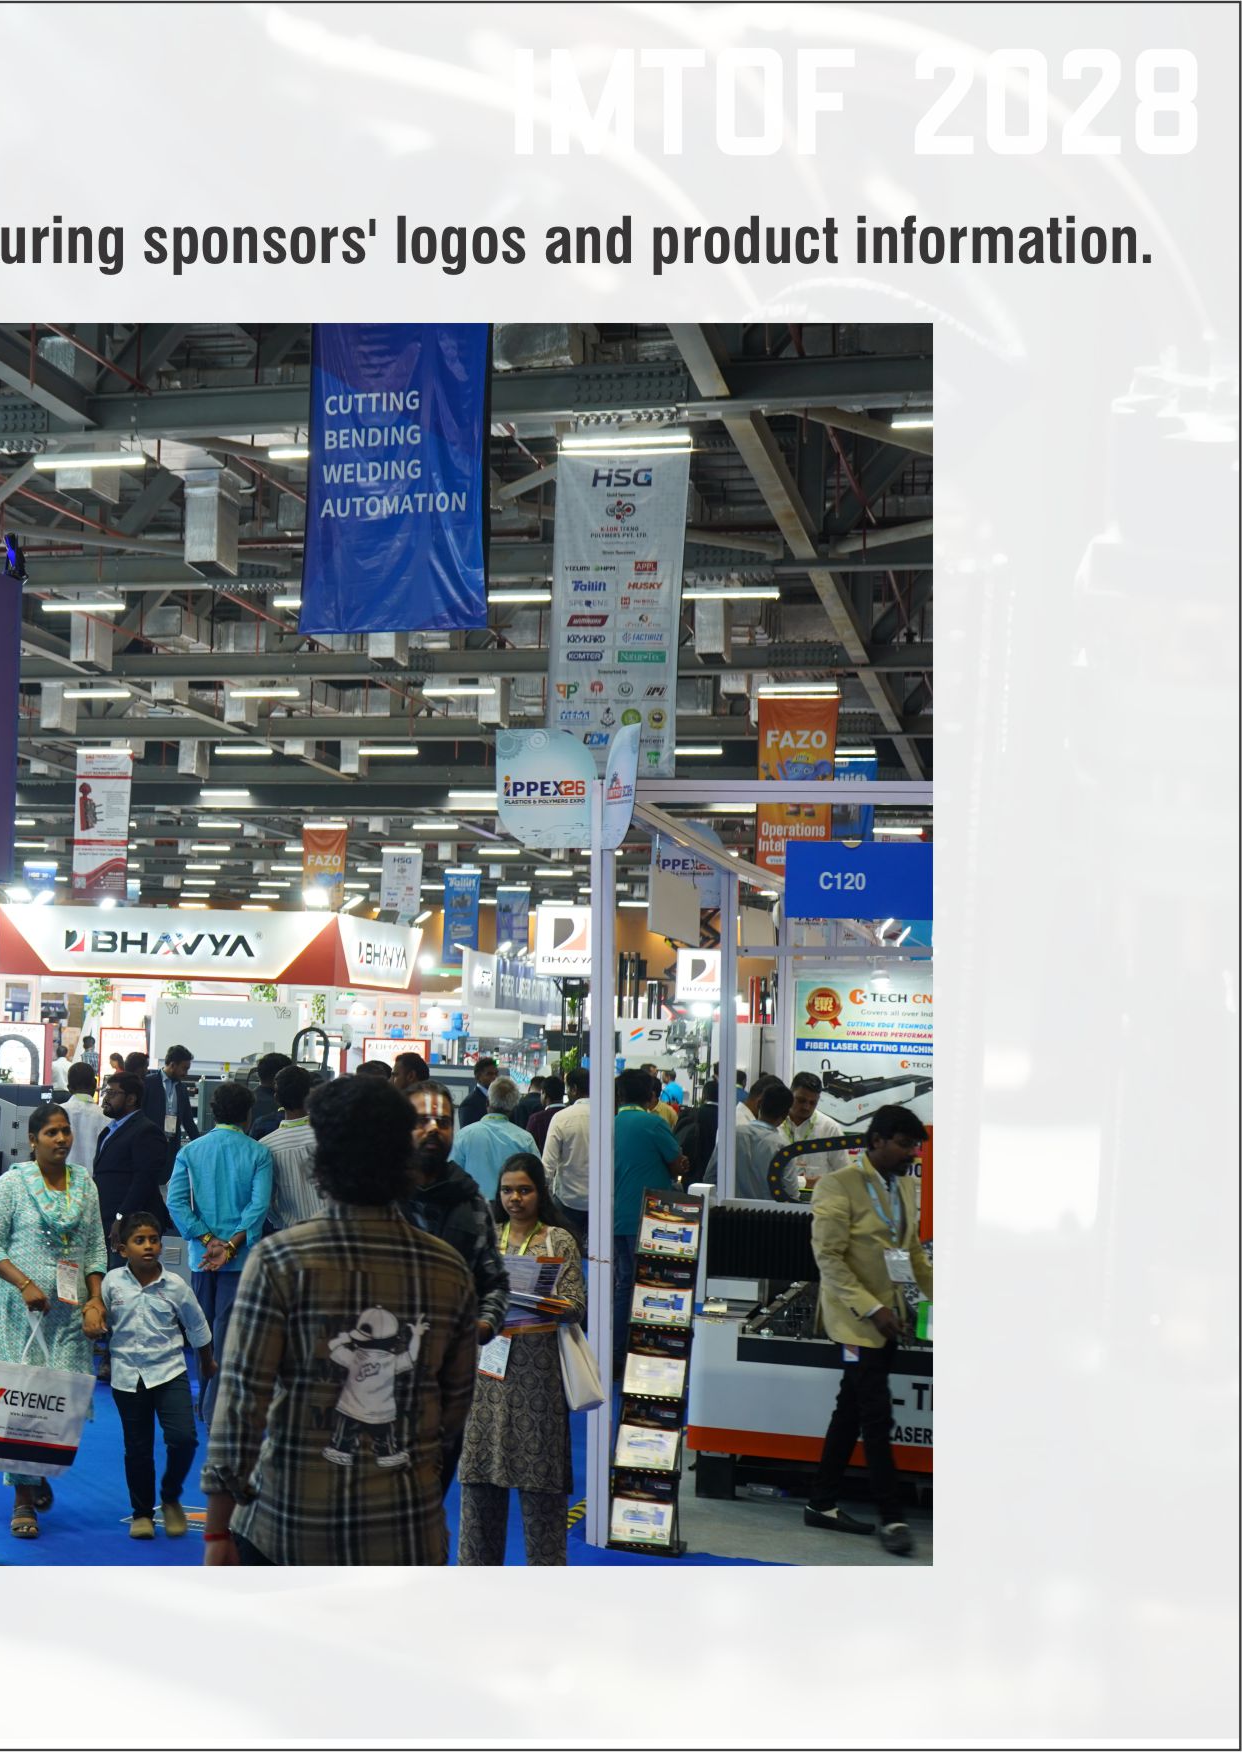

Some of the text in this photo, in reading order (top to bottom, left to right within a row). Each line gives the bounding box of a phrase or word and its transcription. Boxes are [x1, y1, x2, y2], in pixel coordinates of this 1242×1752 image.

[325, 390, 420, 416] CUTTING
[324, 425, 421, 450] BENDING
[323, 458, 422, 484] WELDING
[592, 468, 652, 488] HSG
[320, 491, 467, 518] AUTOMATION
[572, 580, 606, 592] Tailift
[766, 730, 827, 748] FAZO
[761, 822, 825, 838] Operations
[307, 856, 341, 866] FAZO
[819, 872, 866, 890] C120
[90, 930, 255, 958] BHAVYA
[365, 940, 407, 969] BHAVYA
[831, 1042, 858, 1050] LASER
[860, 1044, 898, 1052] CUTTING
